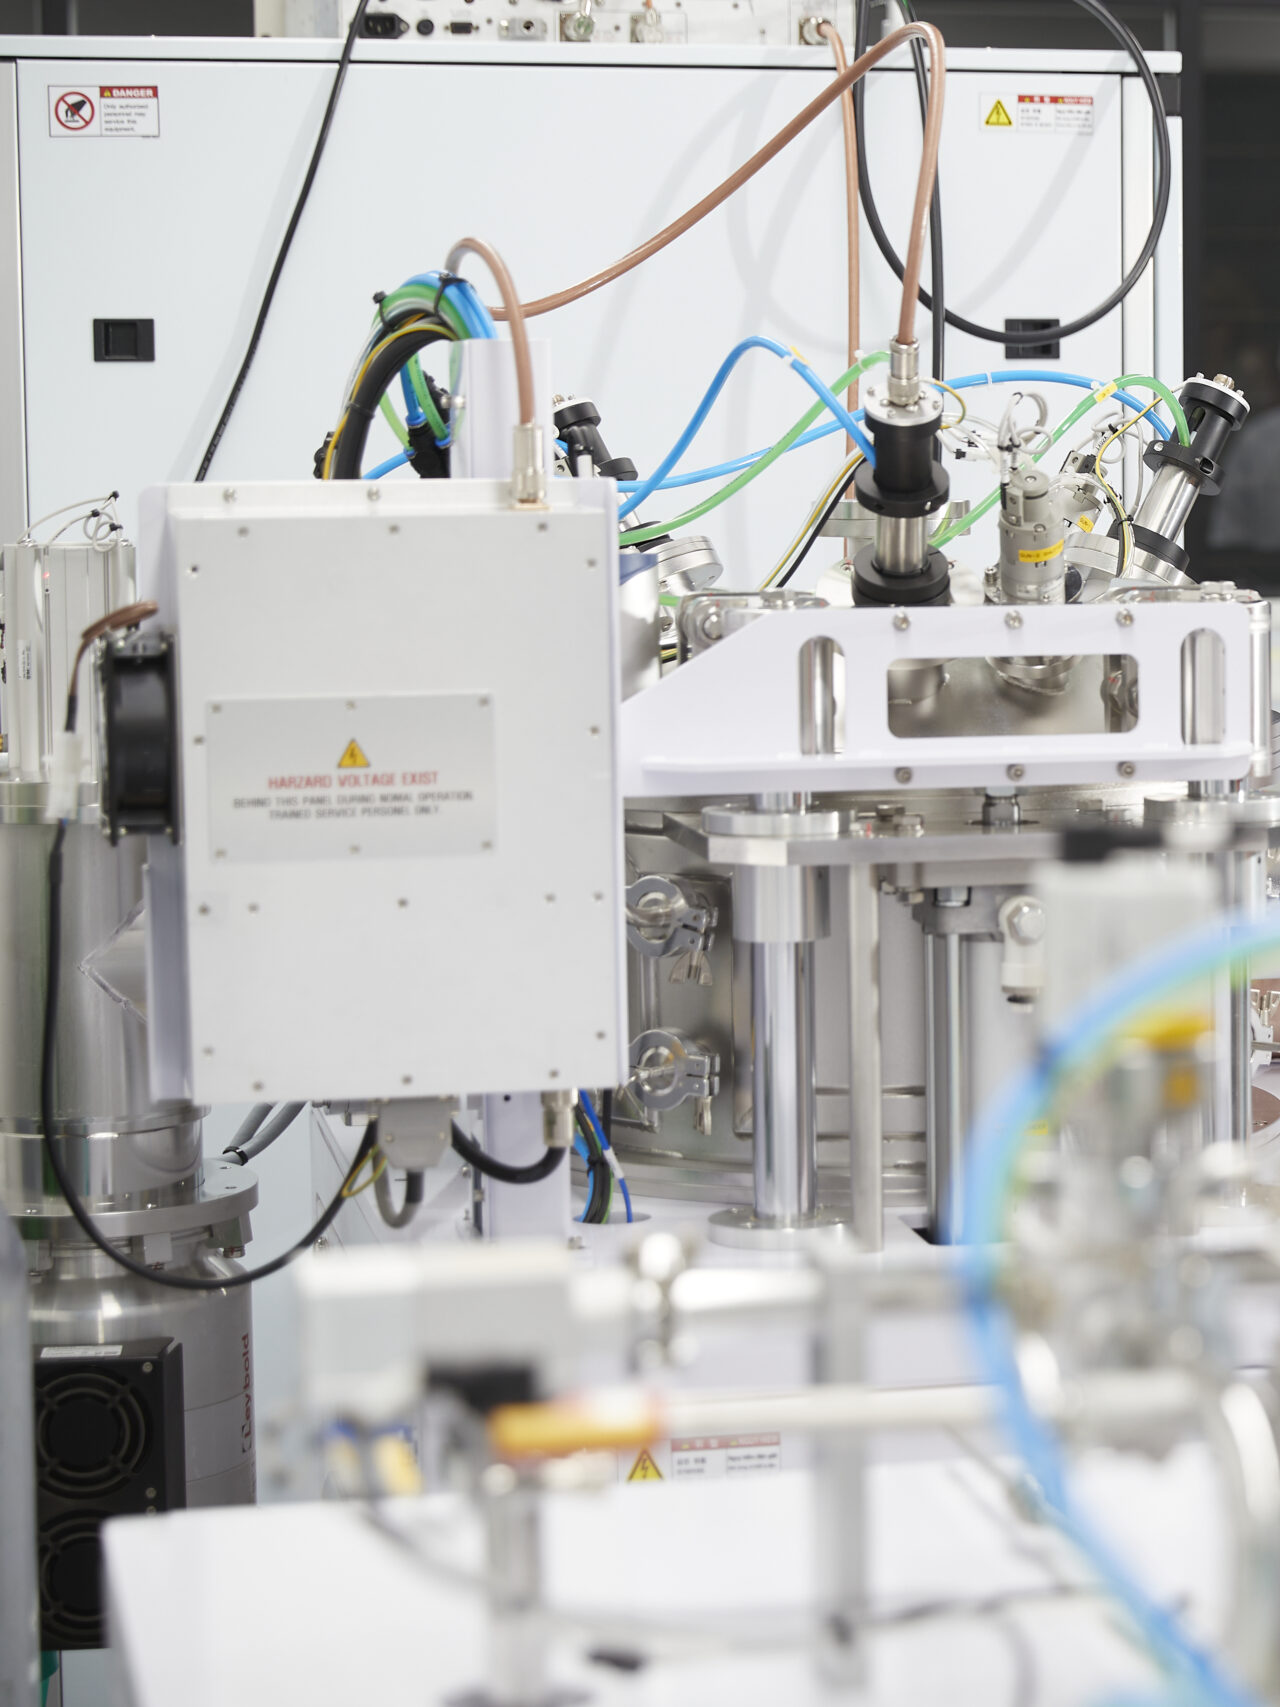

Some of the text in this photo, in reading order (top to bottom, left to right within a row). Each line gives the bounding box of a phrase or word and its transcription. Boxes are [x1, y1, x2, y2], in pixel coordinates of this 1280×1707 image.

[112, 88, 153, 97] DANGER
[268, 771, 438, 789] HARZARD VOLTAGE EXIST
[276, 796, 298, 806] THIS
[418, 791, 473, 801] OPERATION
[316, 808, 356, 818] SERVICE
